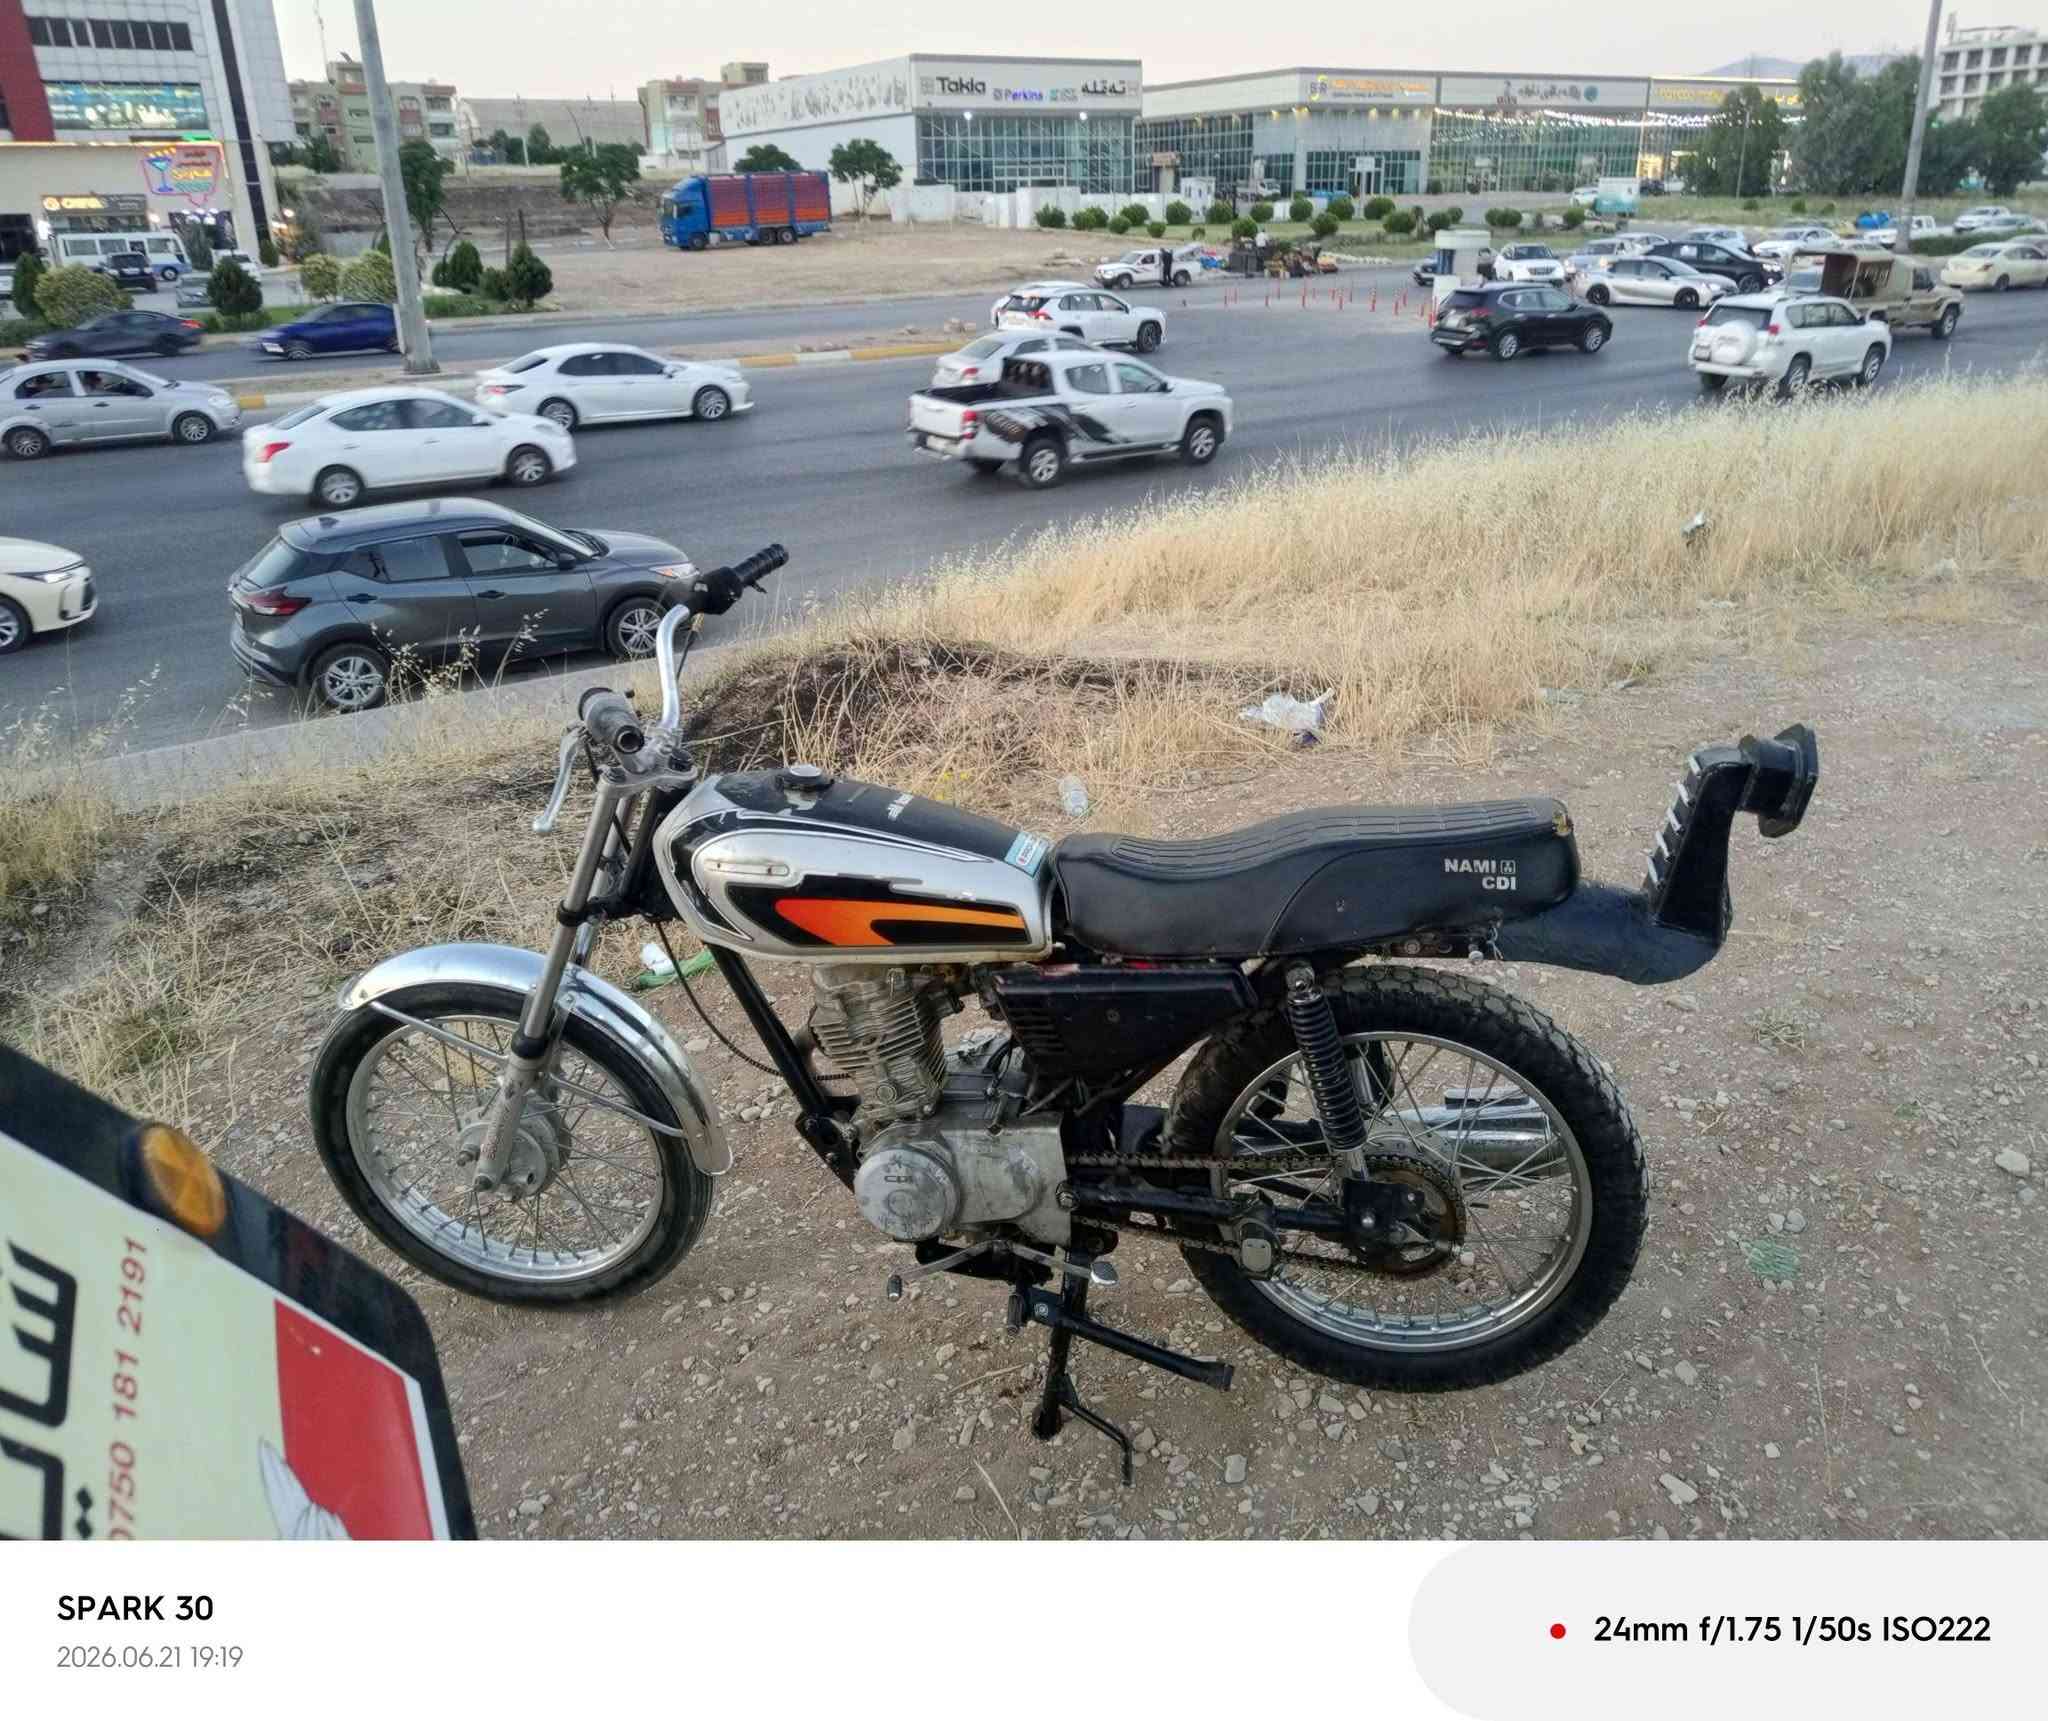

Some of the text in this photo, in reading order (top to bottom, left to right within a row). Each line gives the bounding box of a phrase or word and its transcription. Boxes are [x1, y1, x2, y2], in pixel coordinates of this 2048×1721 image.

[935, 76, 986, 94] Takla
[1444, 858, 1497, 874] NAMI
[1481, 875, 1517, 891] CDI
[117, 1236, 147, 1336] 2191
[112, 1348, 139, 1420] 181
